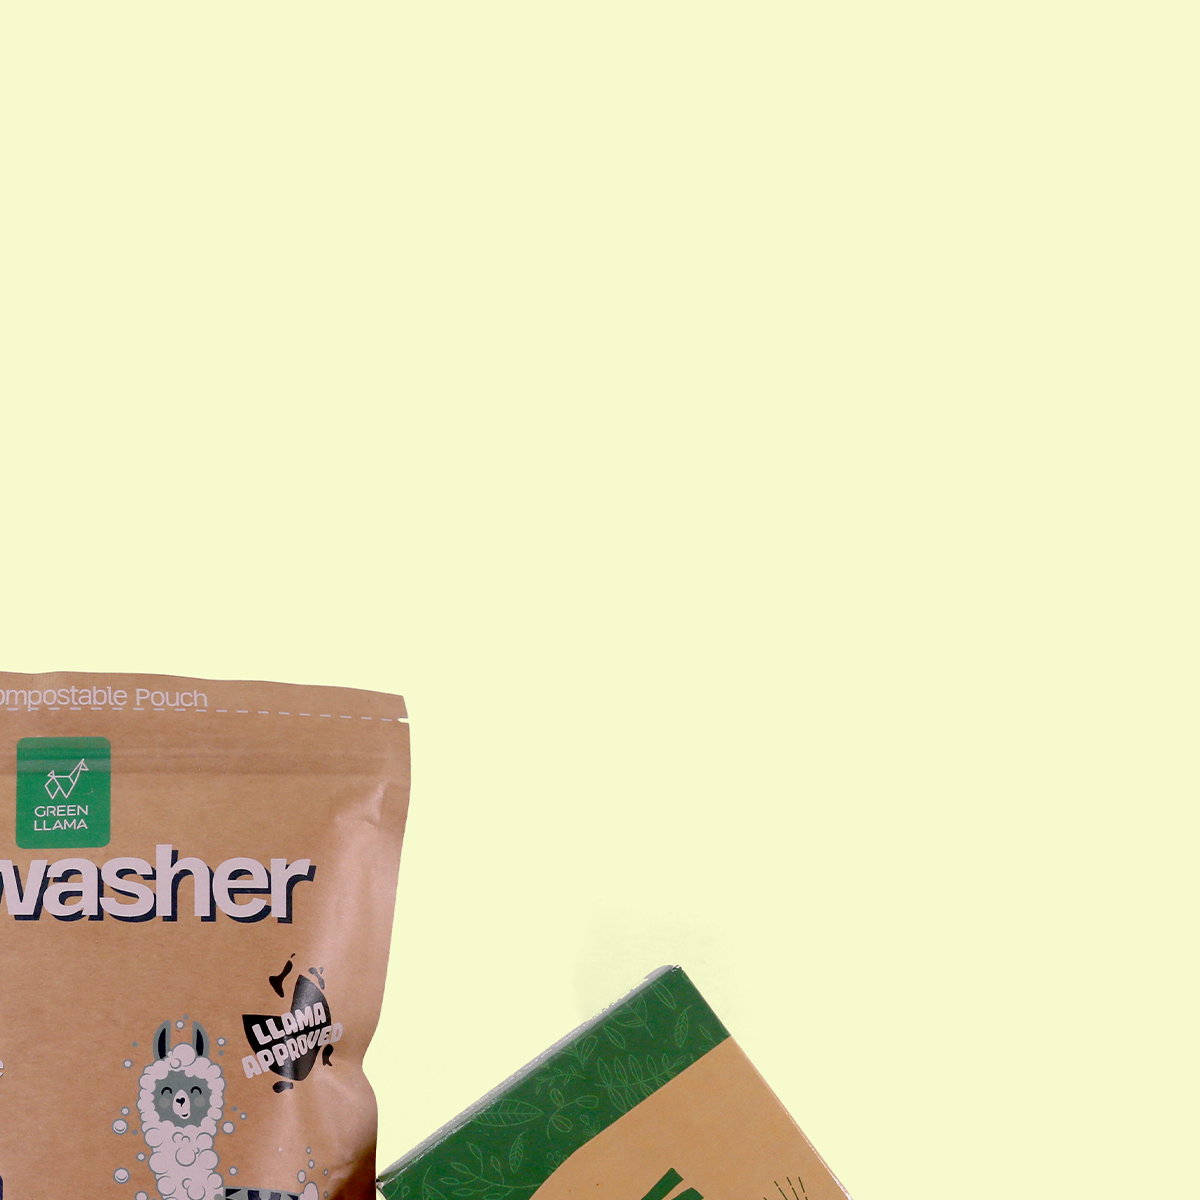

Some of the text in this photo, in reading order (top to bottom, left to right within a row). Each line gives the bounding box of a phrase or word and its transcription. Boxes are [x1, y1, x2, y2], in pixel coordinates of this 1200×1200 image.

[136, 688, 208, 708] Pouch
[34, 805, 89, 817] GREEN
[34, 819, 88, 831] LLAMA
[252, 1002, 327, 1045] LLAMA
[241, 1022, 344, 1079] APPROVED
